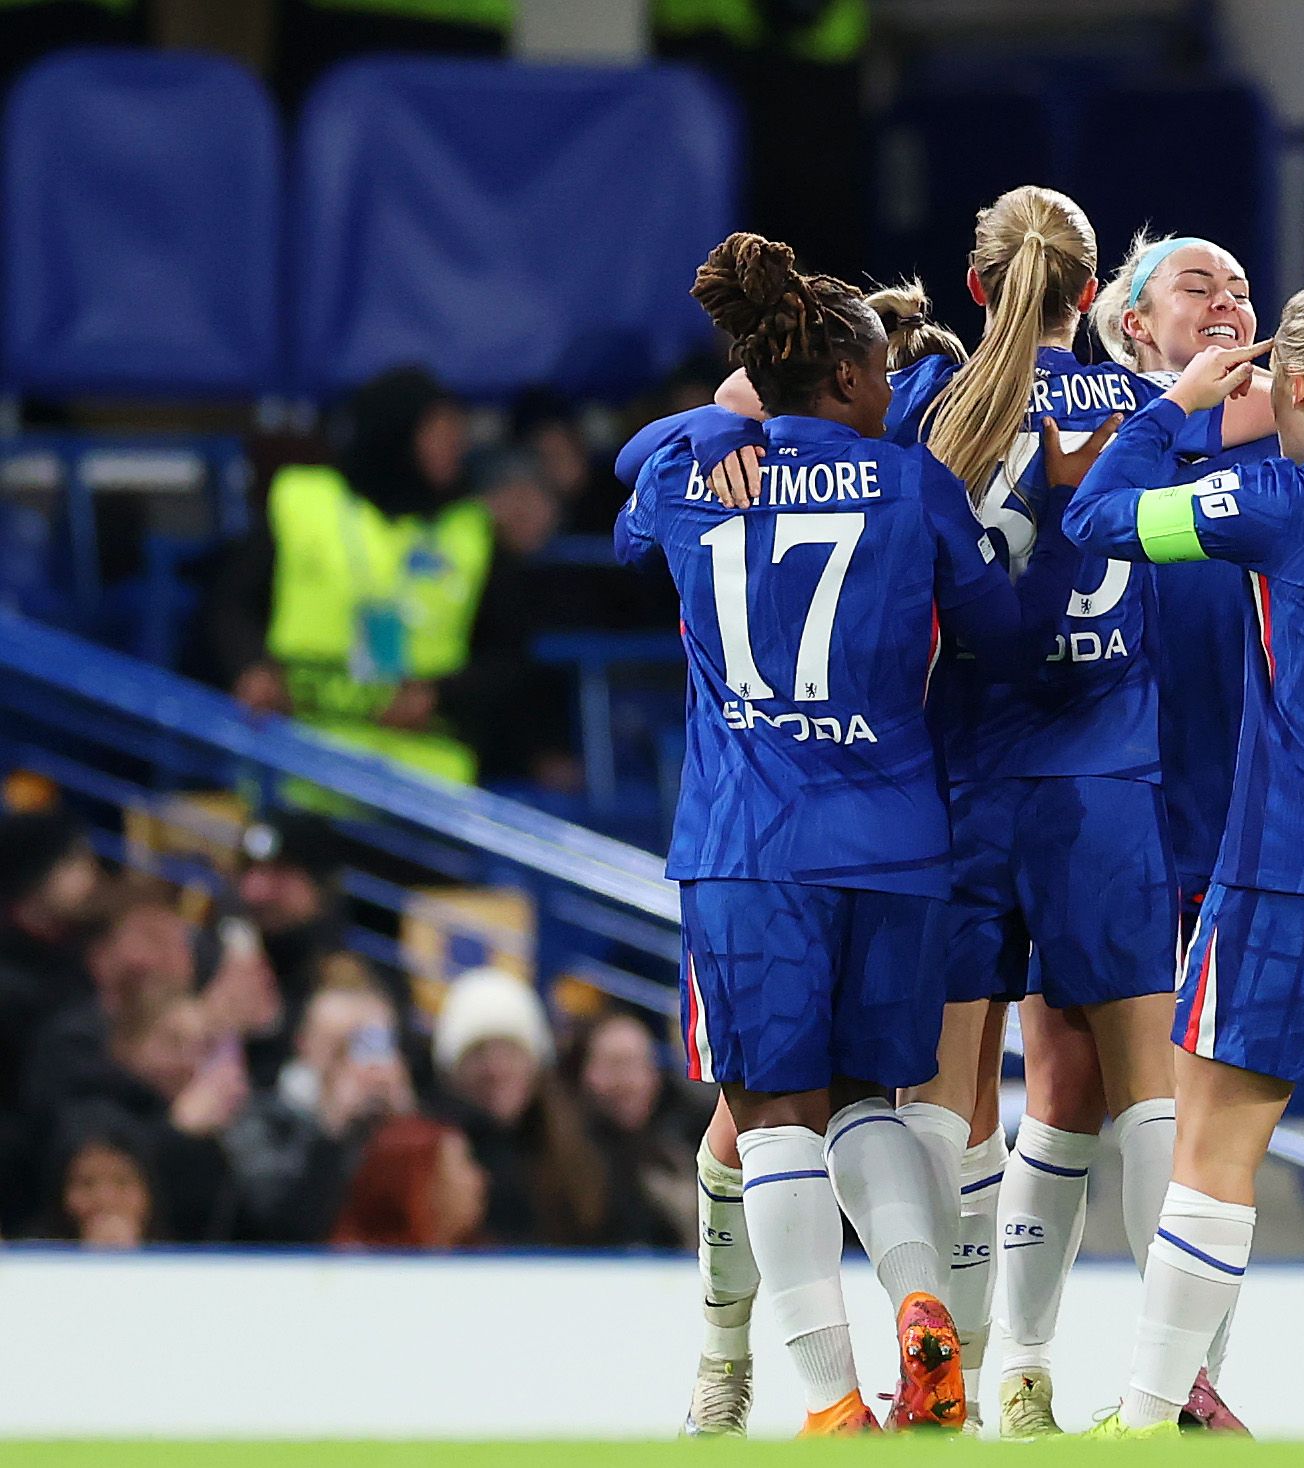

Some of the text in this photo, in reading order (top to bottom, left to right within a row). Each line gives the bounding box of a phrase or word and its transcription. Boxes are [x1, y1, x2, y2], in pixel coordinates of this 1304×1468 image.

[1024, 373, 1136, 415] R-JONES
[701, 513, 865, 701] 17
[1005, 1223, 1045, 1238] CFC
